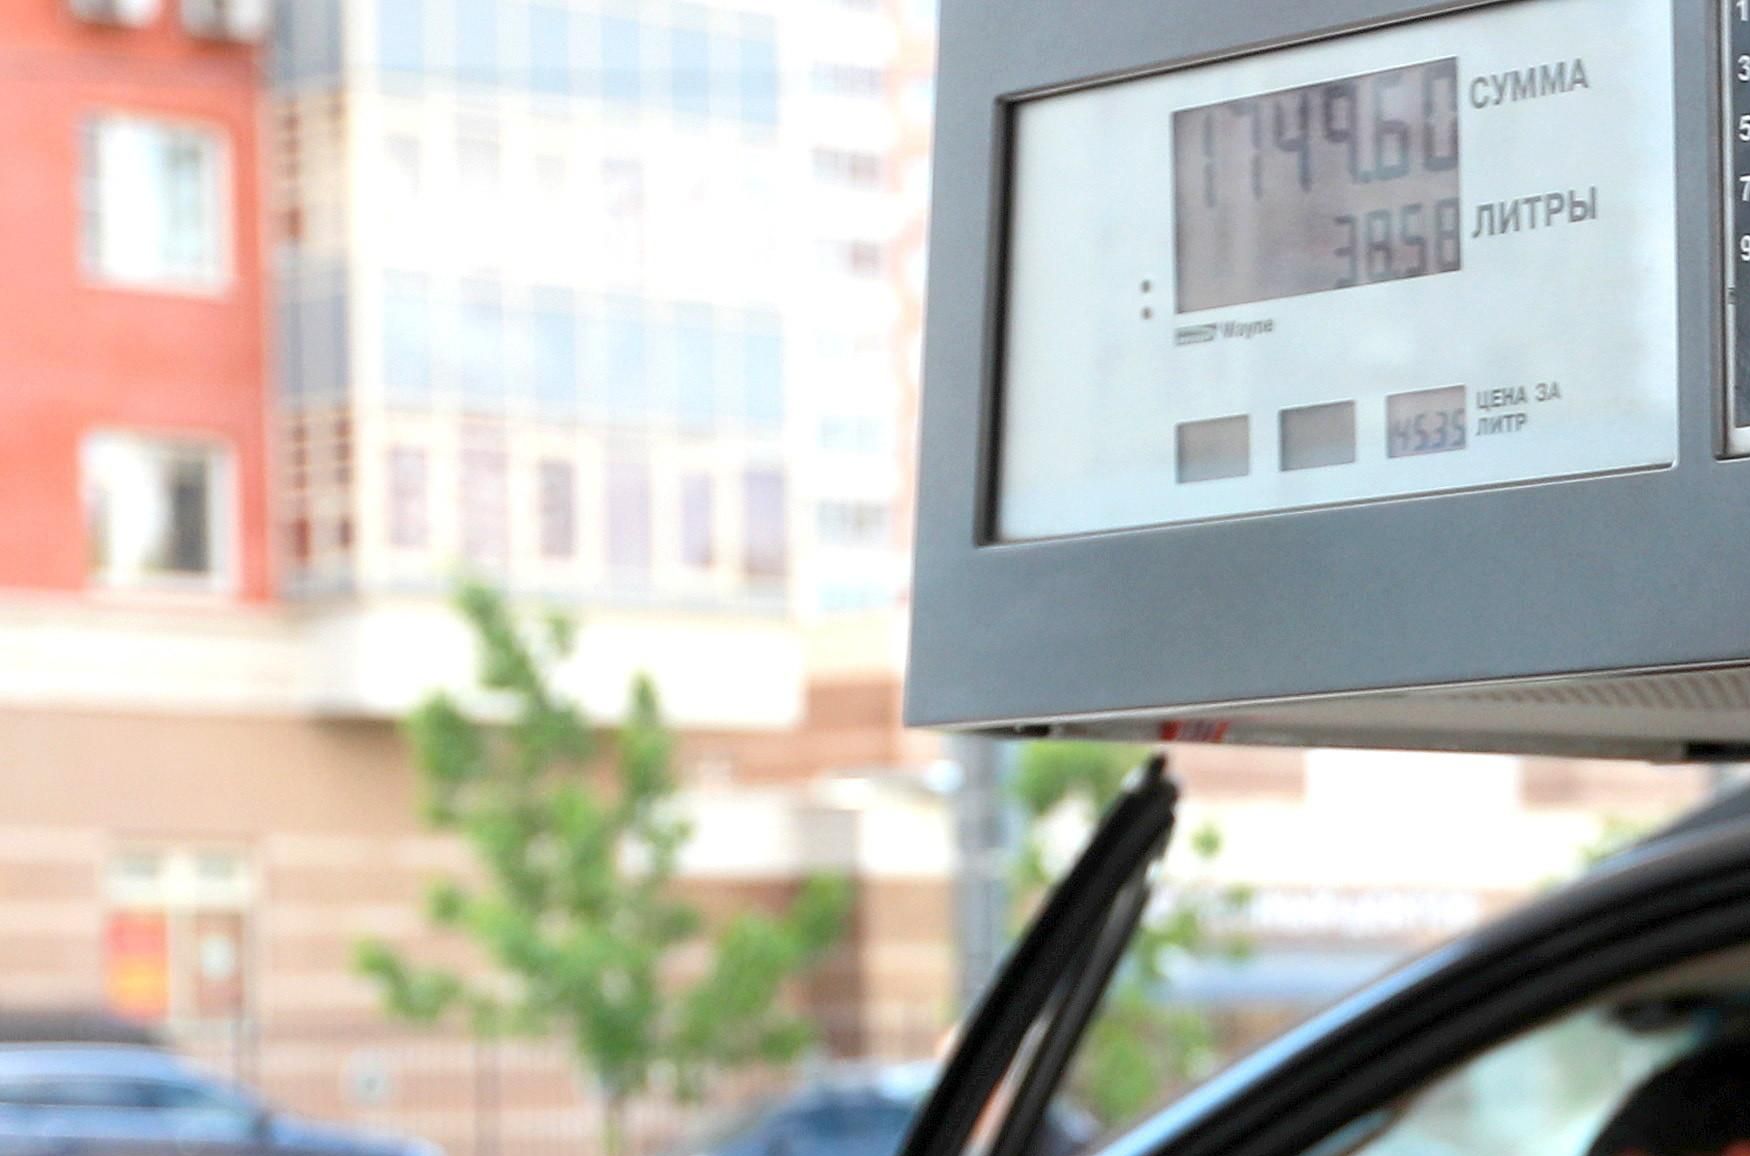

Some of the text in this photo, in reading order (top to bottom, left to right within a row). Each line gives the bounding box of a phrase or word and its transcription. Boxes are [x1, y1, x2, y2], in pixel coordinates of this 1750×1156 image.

[1736, 0, 1749, 21] 1
[1470, 58, 1589, 109] СУММА
[1472, 186, 1597, 239] ЛИТРЫ
[1477, 381, 1561, 411] ЦЕНА ЗА
[1475, 413, 1527, 436] ЛИТР
